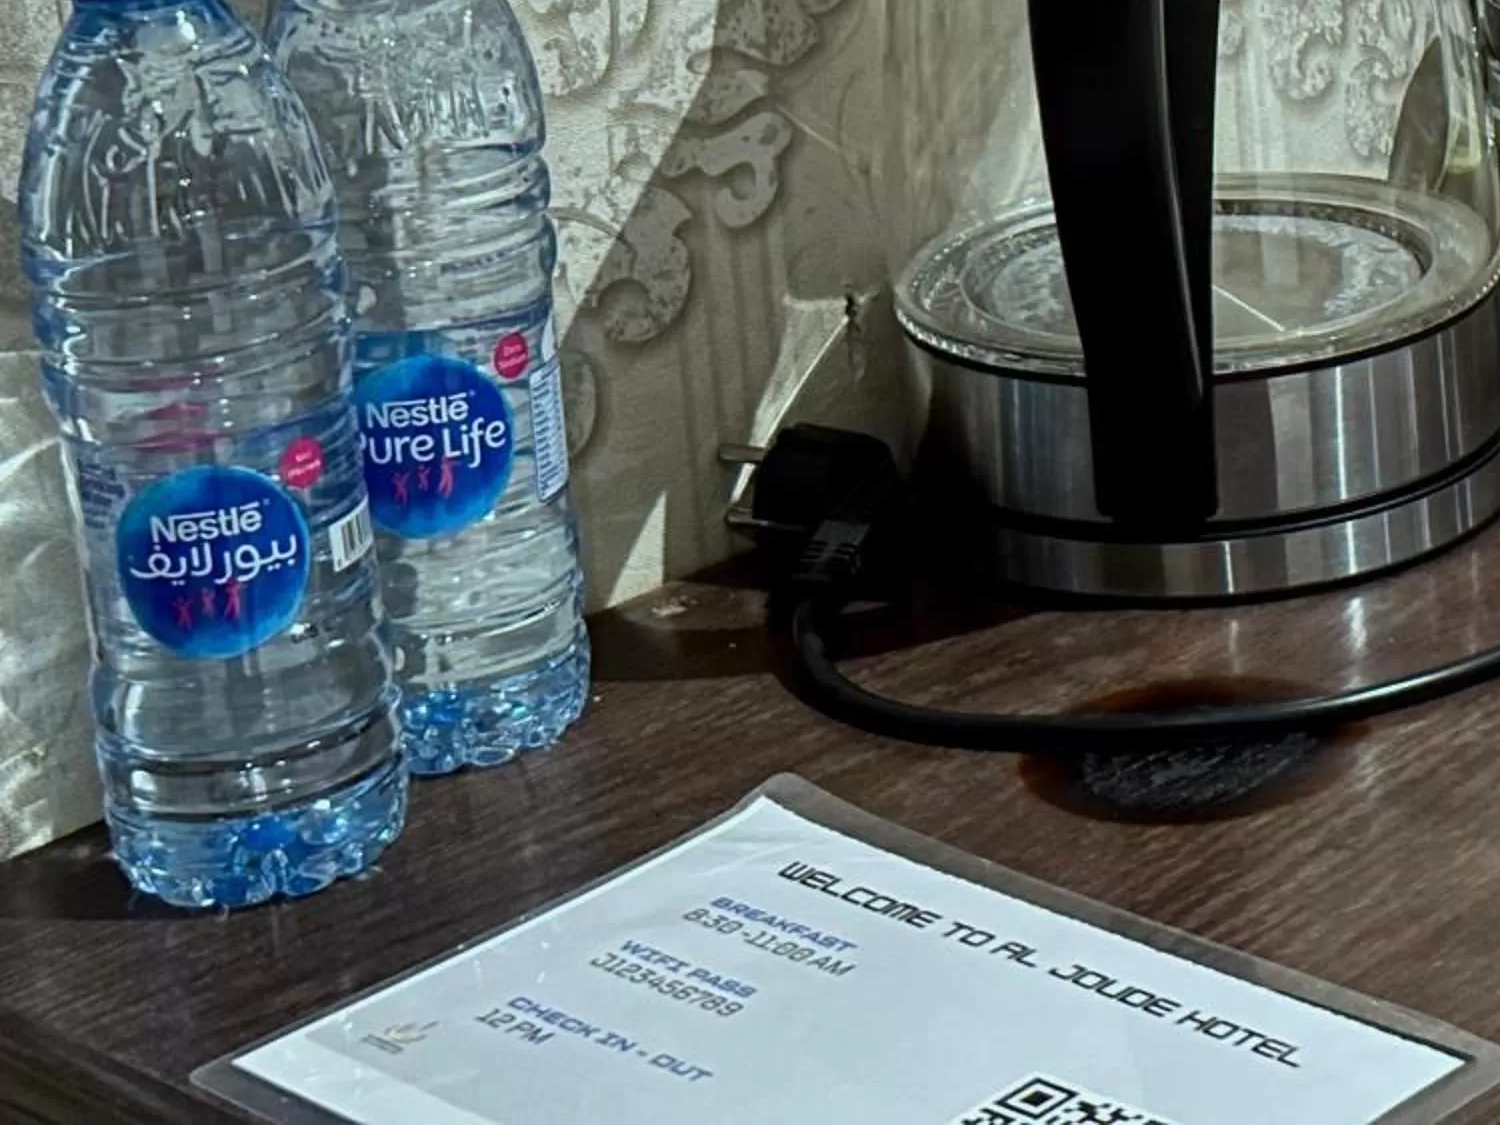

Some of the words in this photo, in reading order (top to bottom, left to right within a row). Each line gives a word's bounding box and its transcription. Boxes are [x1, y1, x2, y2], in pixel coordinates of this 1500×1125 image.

[365, 392, 469, 429] Nestlé
[360, 431, 435, 465] ure
[442, 416, 507, 469] Life
[150, 500, 263, 544] Nestlé
[214, 533, 298, 585] بيور
[709, 896, 859, 952] BREAKFAST
[589, 952, 745, 1017] J123456789
[620, 939, 692, 974] WIFI
[685, 967, 759, 998] PASS
[777, 860, 943, 929] WELCOME
[942, 921, 996, 948] TO
[989, 941, 1039, 968] AL
[1048, 964, 1182, 1017] JOUDE
[1175, 1010, 1302, 1068] HOTEL
[806, 955, 857, 977] AM
[475, 1007, 516, 1029] 12
[504, 1020, 556, 1045] PM
[507, 995, 601, 1039] CHECK
[594, 1031, 637, 1053] IN
[649, 1052, 715, 1082] OUT
